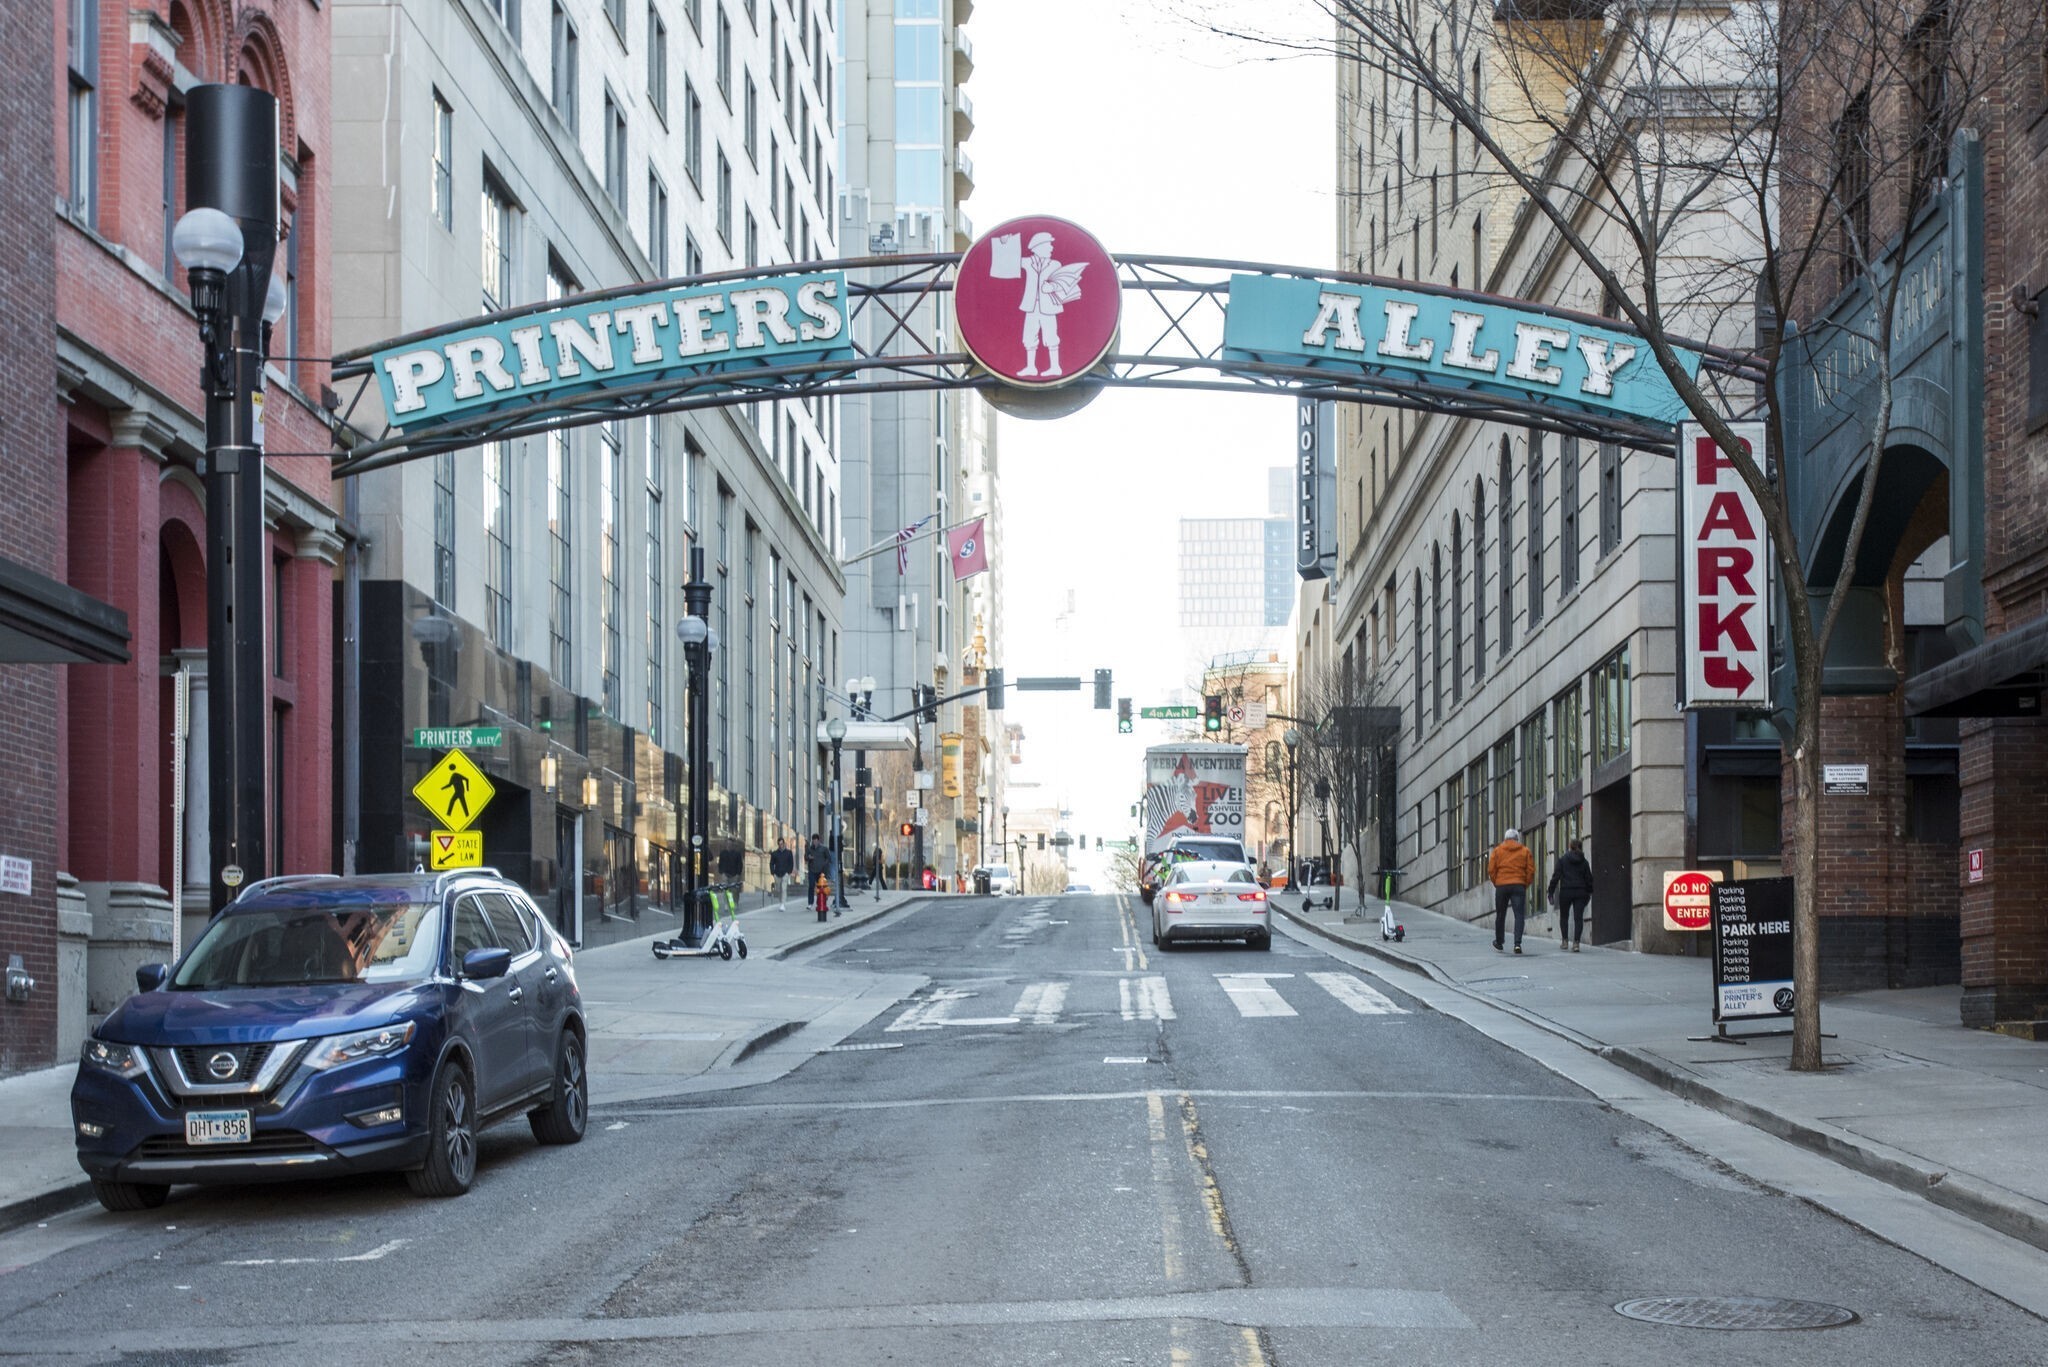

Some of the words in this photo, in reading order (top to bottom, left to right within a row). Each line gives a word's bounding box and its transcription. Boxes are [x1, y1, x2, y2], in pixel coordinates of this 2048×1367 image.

[383, 279, 843, 414] PRINTERS
[1302, 290, 1636, 396] ALLEY
[1301, 405, 1312, 550] NOELLE
[1696, 436, 1758, 652] PARK
[1181, 708, 1190, 717] N
[420, 730, 473, 746] PRINTERS
[476, 737, 495, 745] ALLEY
[1152, 757, 1185, 770] ZEBRA
[1203, 788, 1242, 801] LIVE!
[1204, 813, 1242, 825] ZOO
[457, 840, 477, 849] STATE
[460, 853, 475, 861] LAW
[1673, 883, 1688, 893] DO
[1718, 887, 1745, 895] Parking
[1719, 896, 1746, 904] Parking
[1677, 908, 1710, 918] ENTER
[1720, 904, 1747, 913] Parking
[1721, 913, 1747, 921] Parking
[1722, 924, 1756, 937] PARK
[1759, 921, 1790, 934] HERE
[1723, 938, 1749, 947] Parking
[1723, 947, 1749, 956] Parking
[1723, 956, 1749, 965] Parking
[1723, 965, 1750, 974] Parking
[1723, 974, 1750, 982] Parking
[1724, 993, 1763, 1002] PRINTER'S
[1724, 1002, 1747, 1010] ALLEY
[190, 1121, 213, 1137] DHT
[223, 1119, 246, 1135] 858
